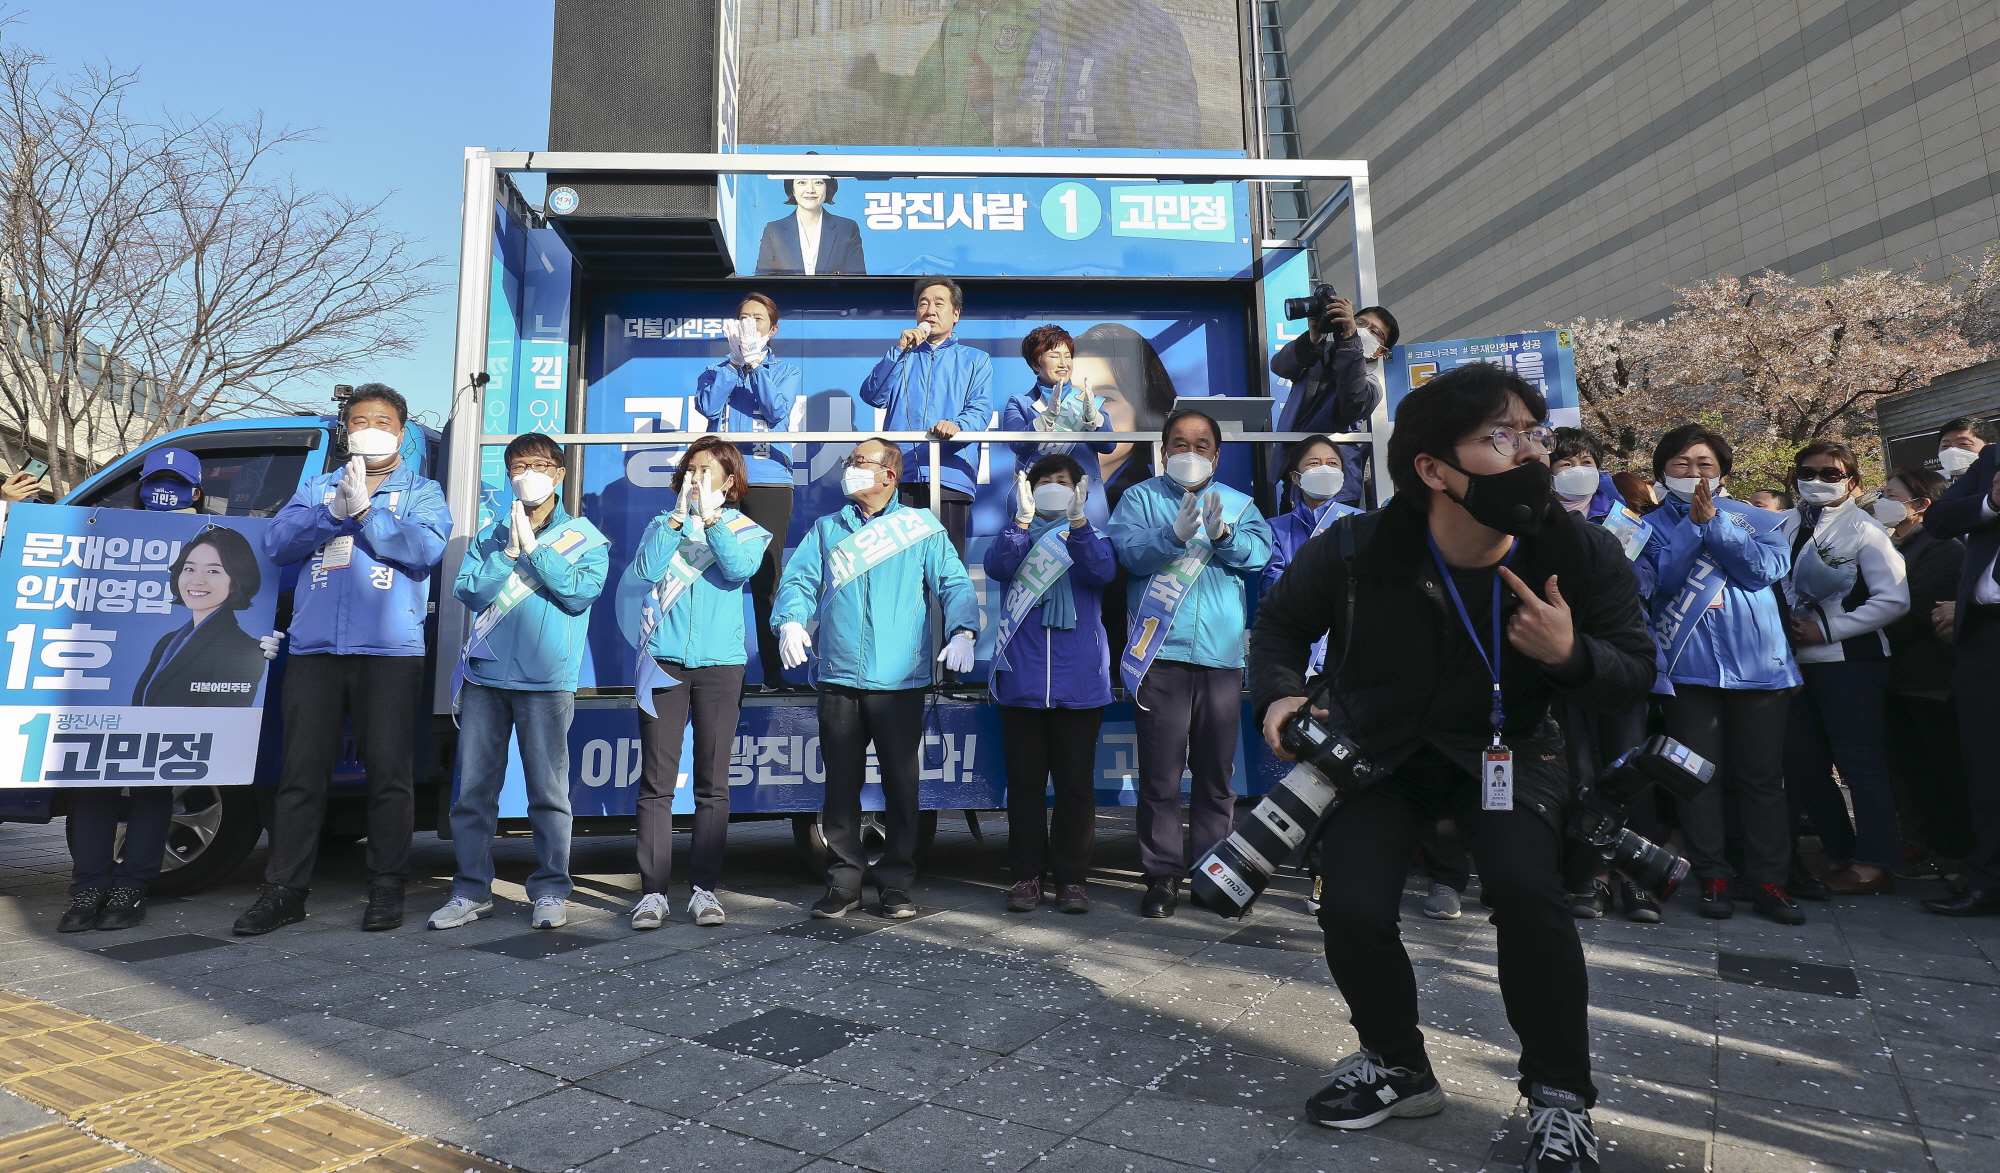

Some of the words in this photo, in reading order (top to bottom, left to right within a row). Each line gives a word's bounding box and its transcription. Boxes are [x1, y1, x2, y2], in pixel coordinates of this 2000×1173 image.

[864, 191, 1027, 232] 광진사람
[1058, 189, 1078, 233] 1
[1118, 194, 1227, 231] 고민정
[1415, 348, 1459, 359] 코로나극복
[1469, 342, 1519, 355] 문재인정부
[1521, 339, 1542, 350] 성공
[165, 451, 175, 465] 1
[151, 492, 179, 507] 고민정
[21, 532, 182, 573] 문재인의
[828, 509, 932, 589] 전혜숙
[15, 574, 174, 615] 인재영입
[5, 623, 118, 690] 1호
[1130, 615, 1160, 661] 1
[190, 681, 252, 693] 더불어민주당
[56, 714, 122, 731] 광진사람
[18, 713, 51, 782] 1
[44, 732, 214, 780] 고민정
